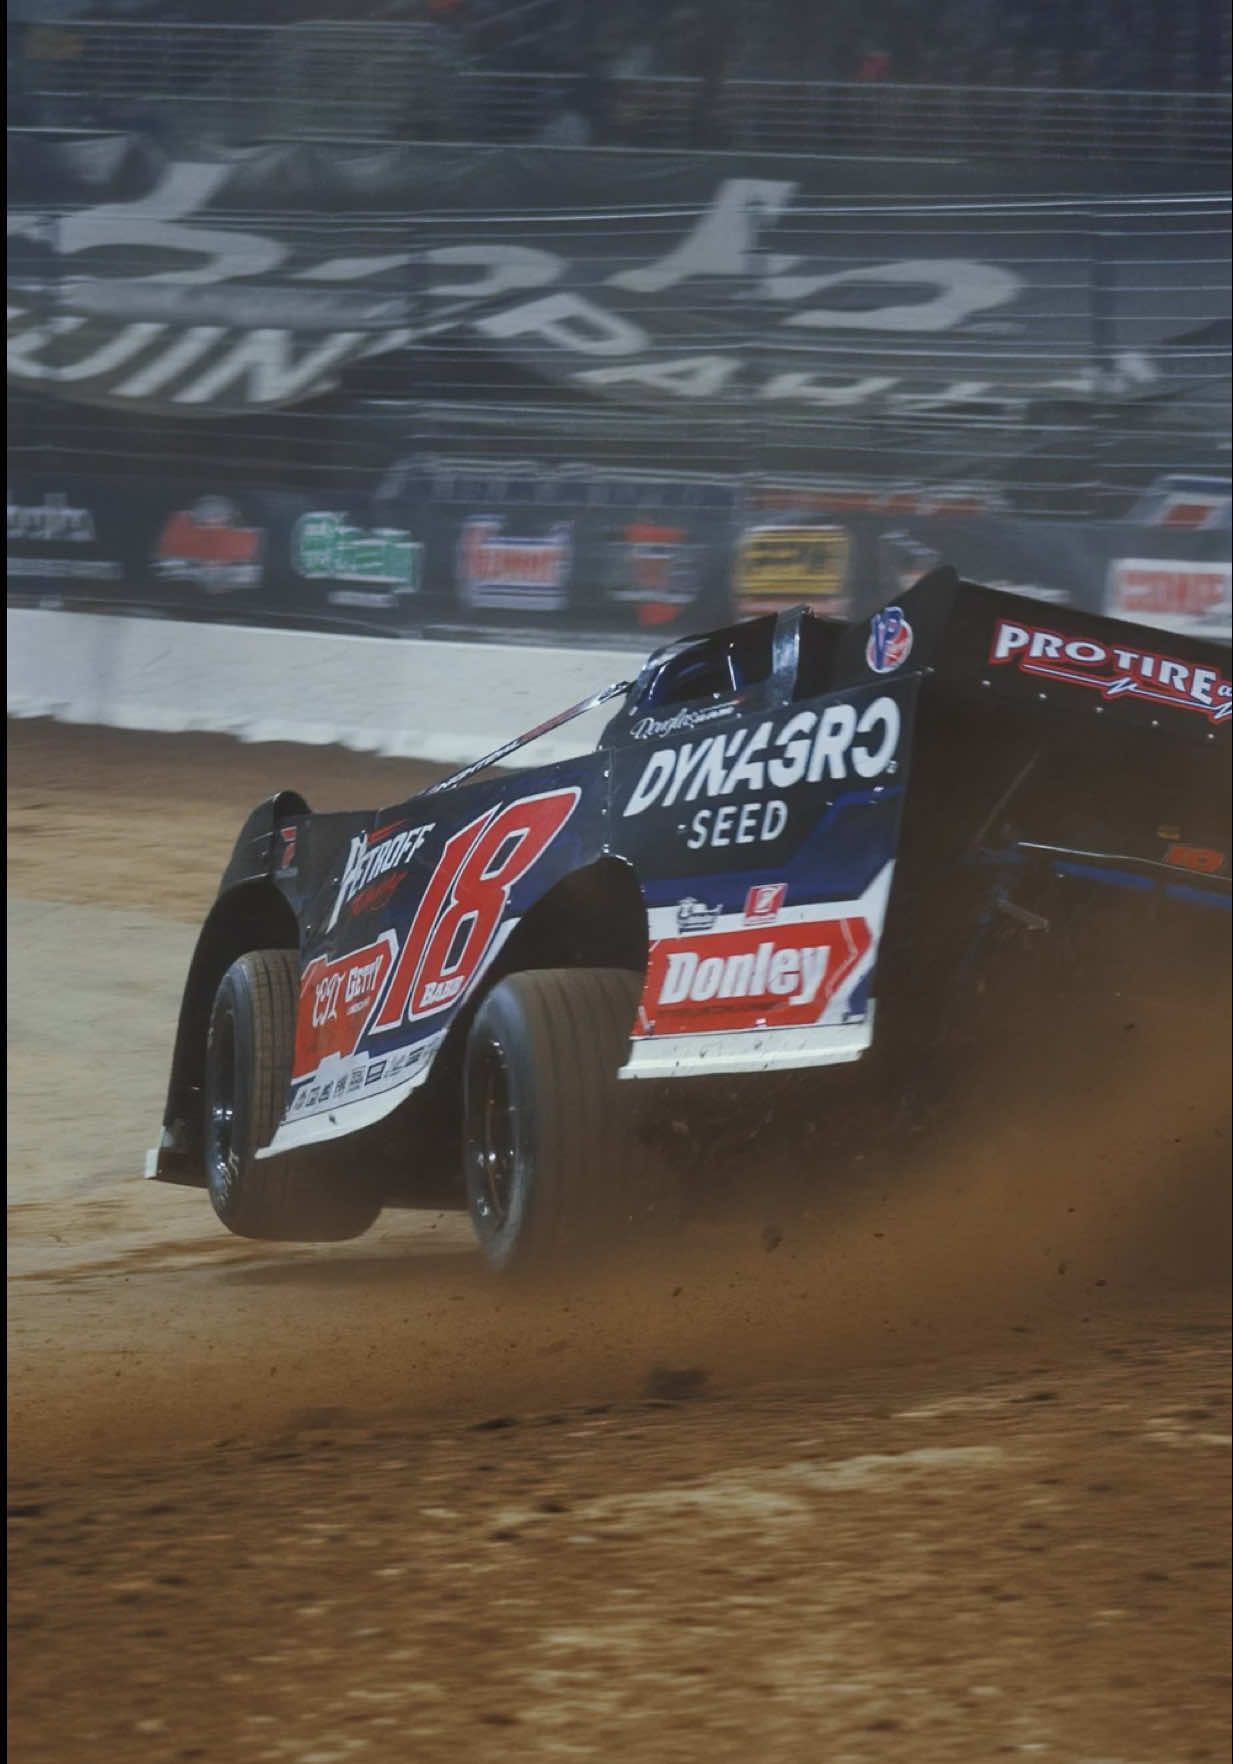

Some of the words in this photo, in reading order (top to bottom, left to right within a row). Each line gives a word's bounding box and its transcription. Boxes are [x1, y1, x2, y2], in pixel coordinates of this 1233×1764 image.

[994, 622, 1106, 662] PRO
[1112, 648, 1217, 705] TIRE
[622, 697, 900, 817] DYNAGRO
[687, 800, 788, 849] SEED
[368, 786, 582, 1035] 18
[658, 942, 831, 1006] Donley
